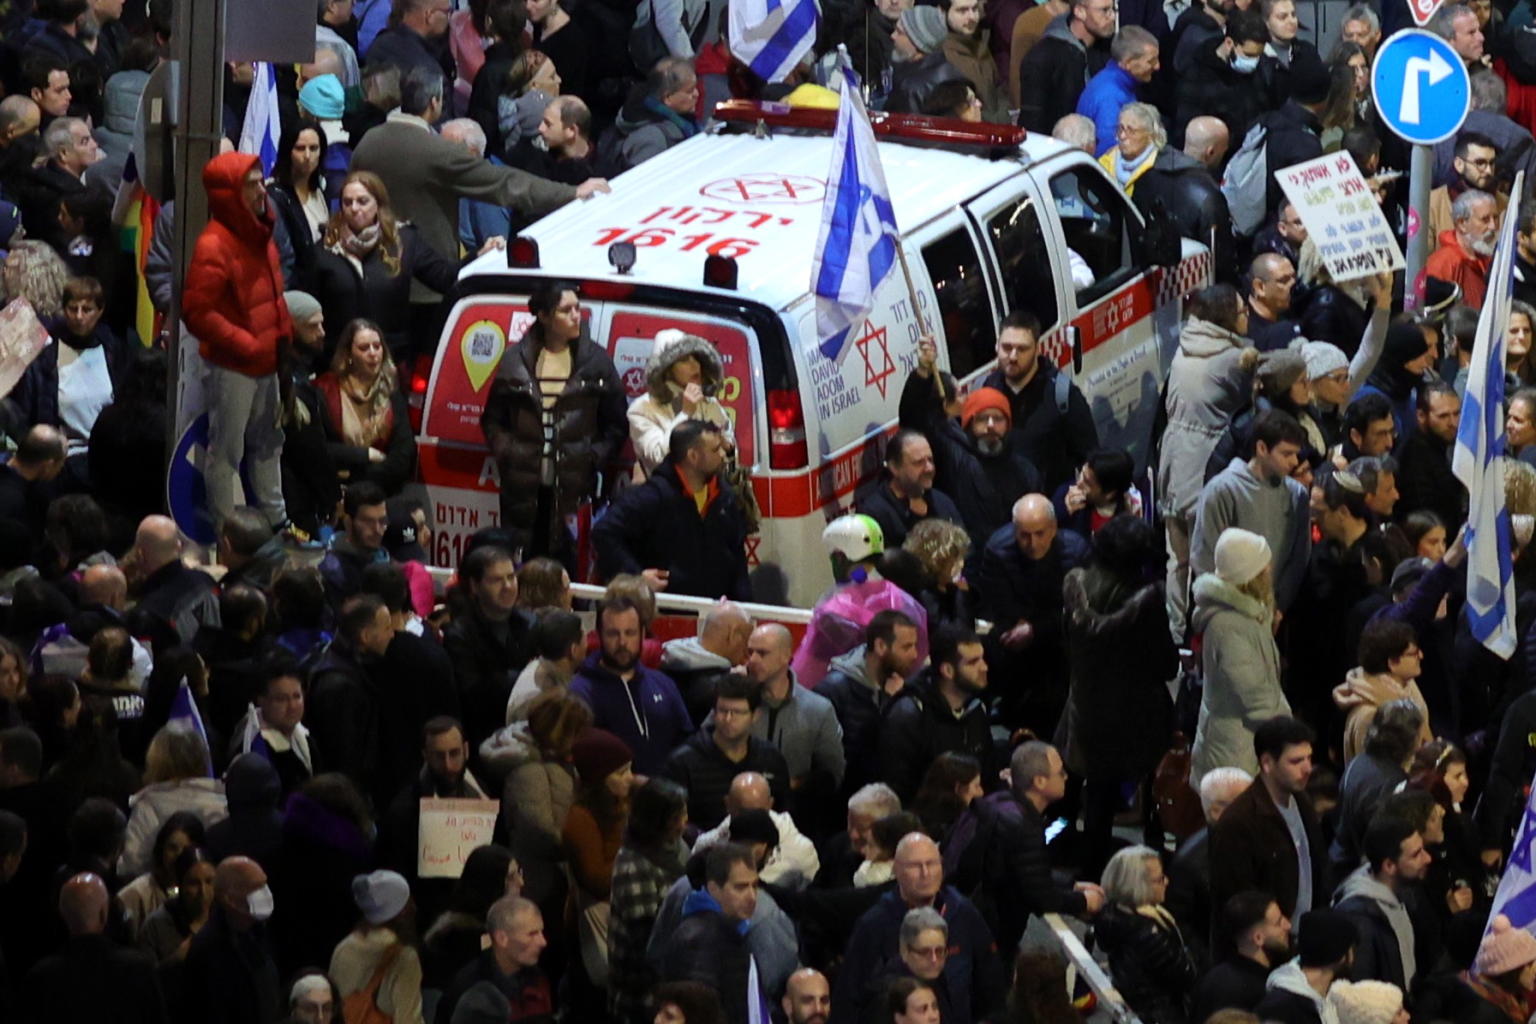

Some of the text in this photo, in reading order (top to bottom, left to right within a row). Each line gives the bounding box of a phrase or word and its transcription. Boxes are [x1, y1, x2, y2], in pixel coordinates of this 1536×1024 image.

[1334, 155, 1351, 175] לא
[638, 205, 795, 228] ירקון
[592, 227, 760, 259] 1616
[811, 361, 840, 386] DAVID
[816, 373, 845, 403] ADOM
[818, 385, 862, 421] IN ISRAEL
[436, 501, 480, 528] אדום
